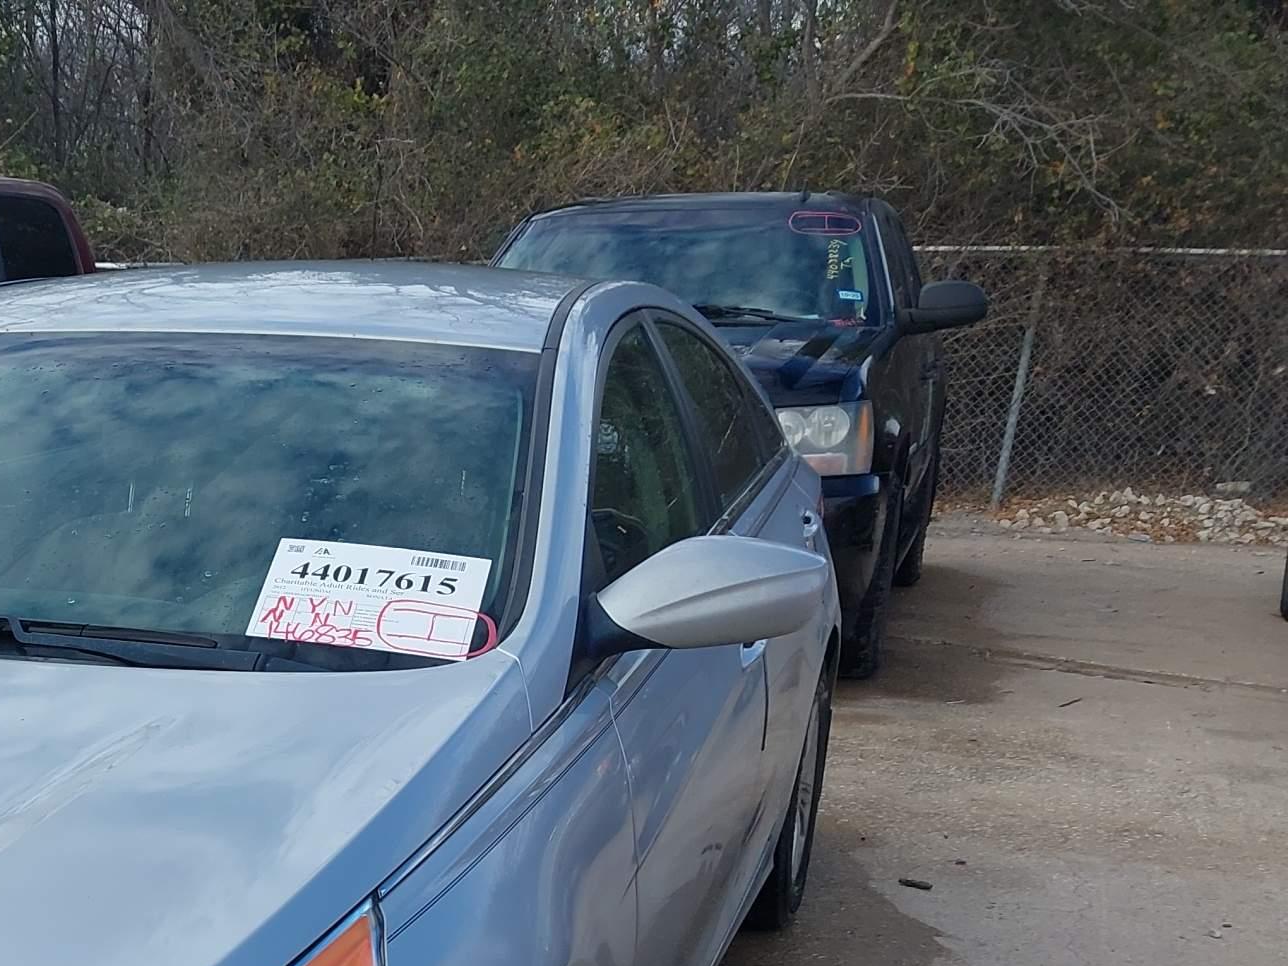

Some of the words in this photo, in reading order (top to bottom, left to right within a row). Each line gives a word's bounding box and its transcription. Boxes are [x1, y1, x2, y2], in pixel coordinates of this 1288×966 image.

[274, 577, 318, 588] Charitable
[320, 581, 344, 590] Adult
[346, 584, 370, 593] Rides
[372, 587, 388, 595] and
[290, 561, 460, 596] 44017615
[309, 597, 327, 613] Y
[333, 600, 353, 616] N
